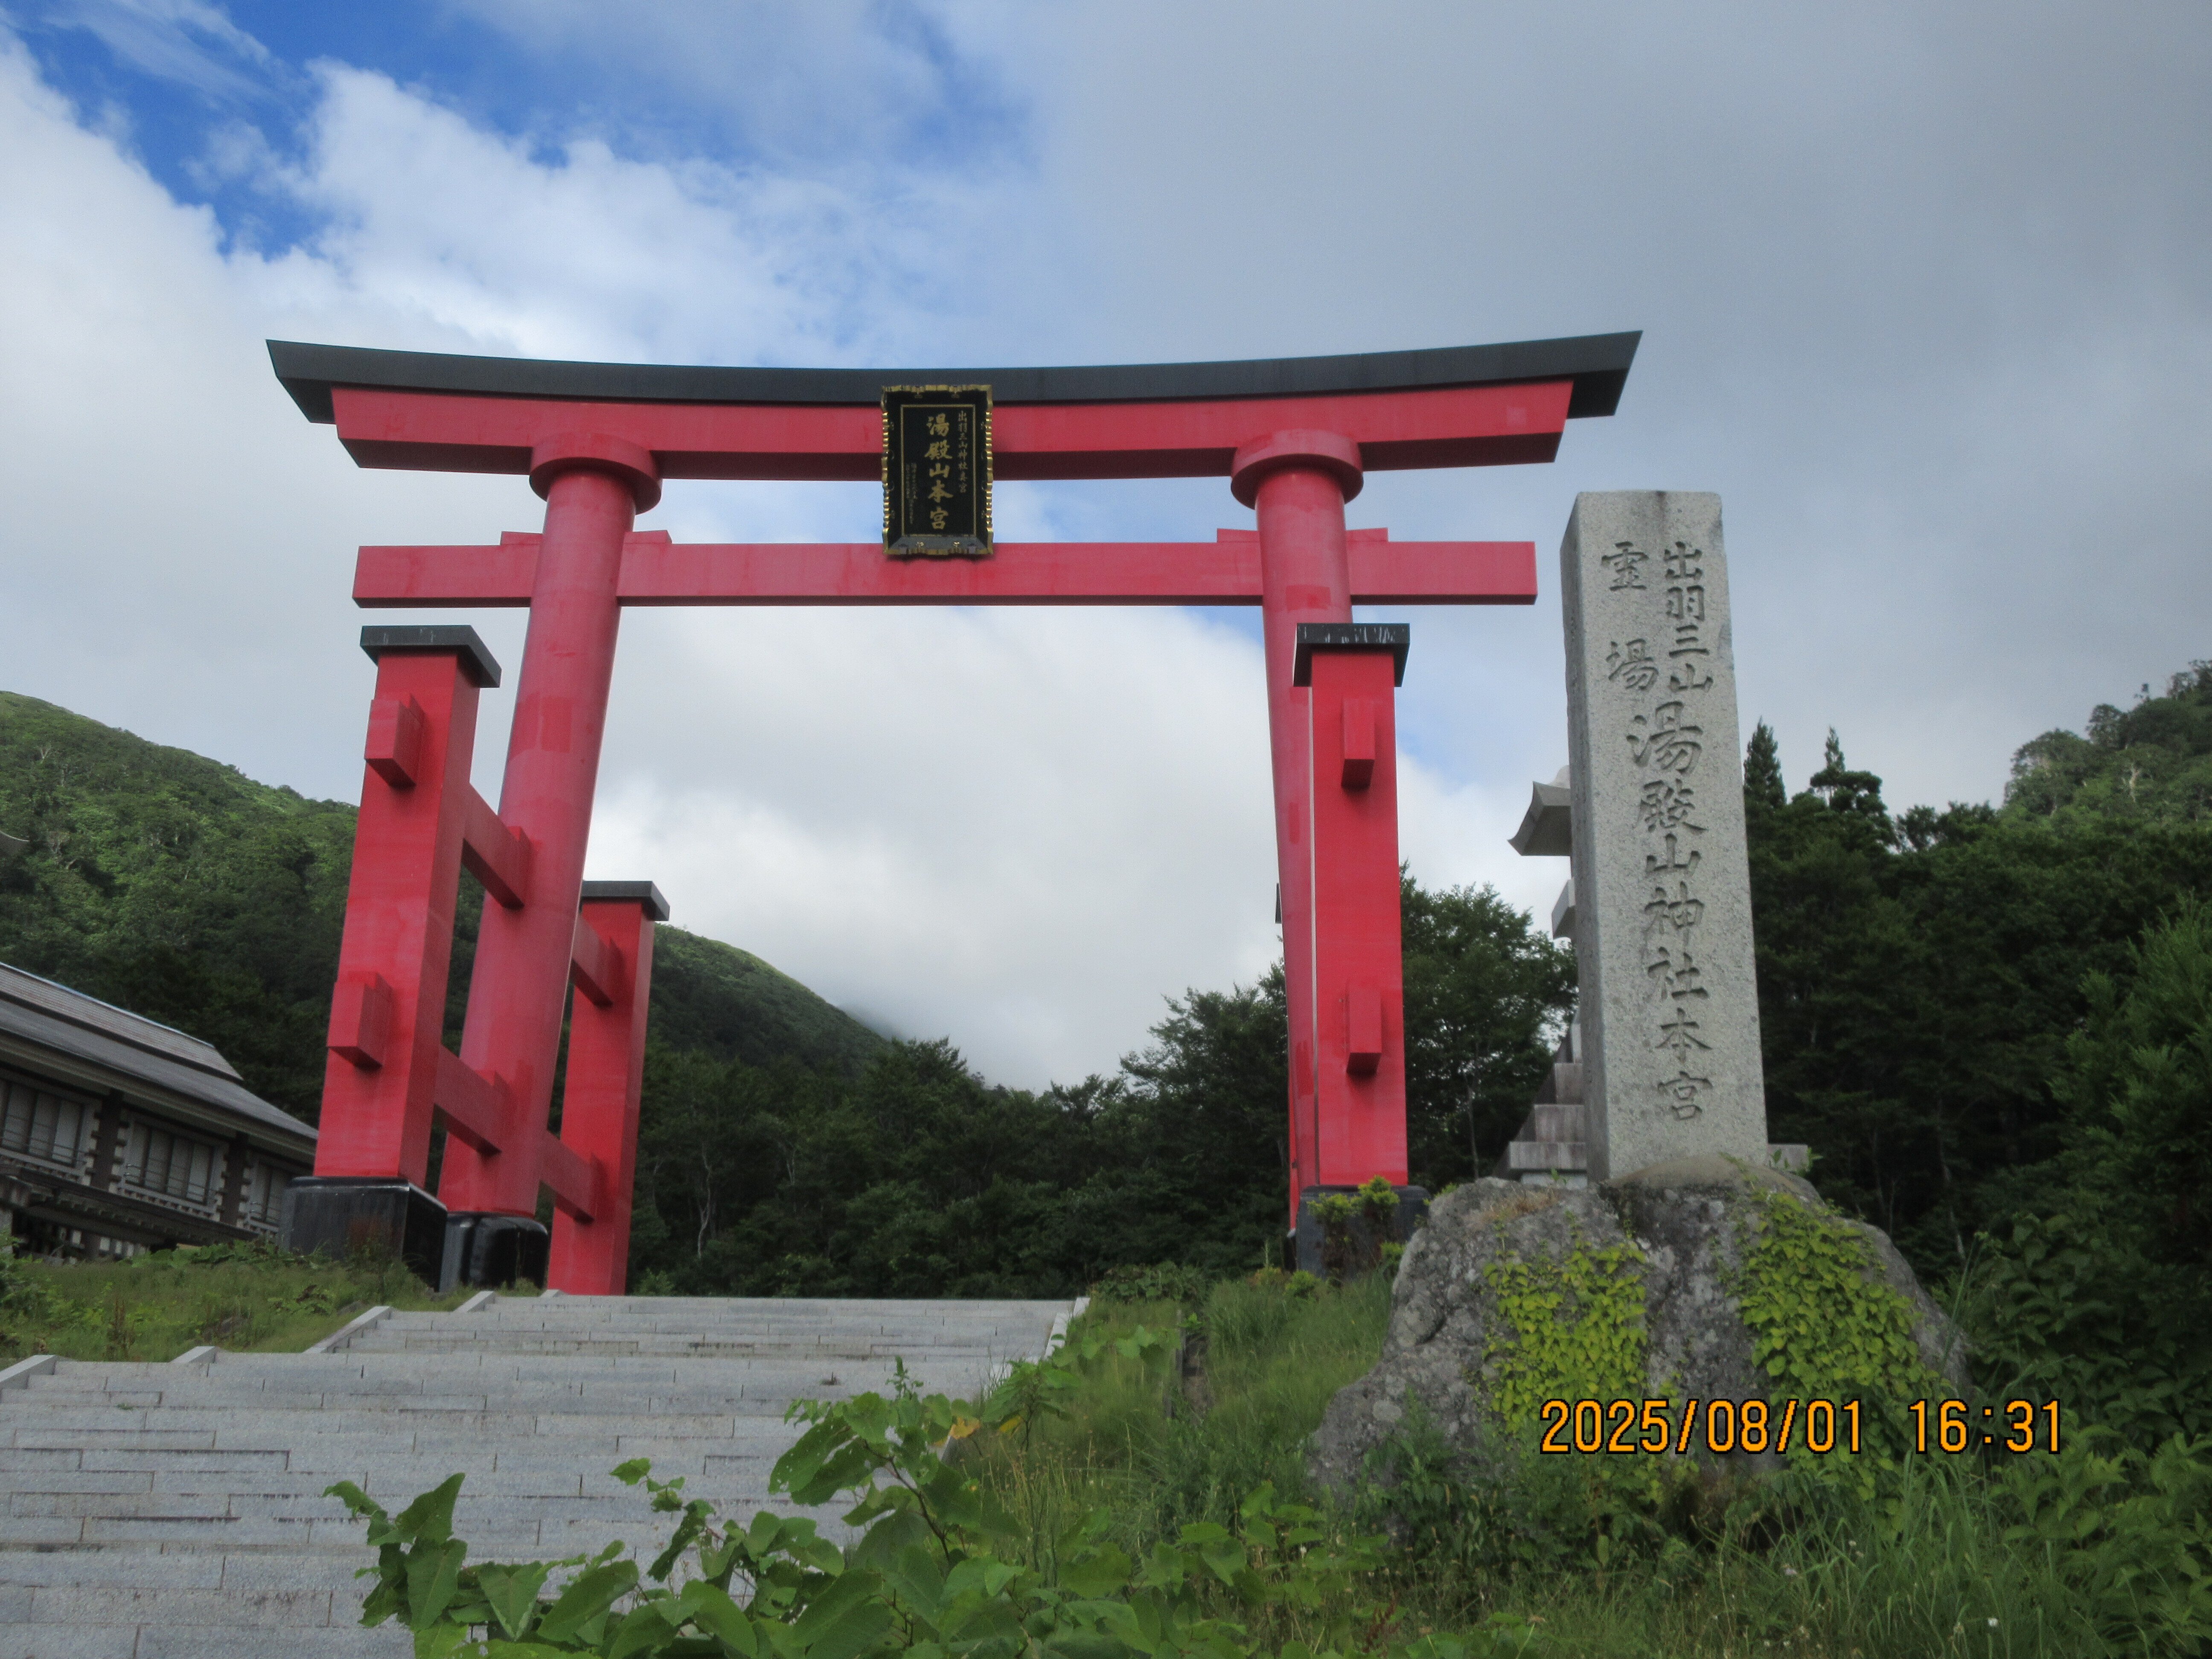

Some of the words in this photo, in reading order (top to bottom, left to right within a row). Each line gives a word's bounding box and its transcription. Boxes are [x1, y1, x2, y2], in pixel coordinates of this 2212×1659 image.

[925, 413, 953, 530] 湯殿山本宮
[1662, 541, 1714, 693] 出羽三山
[1626, 701, 1714, 1121] 湯殿山神社本宮
